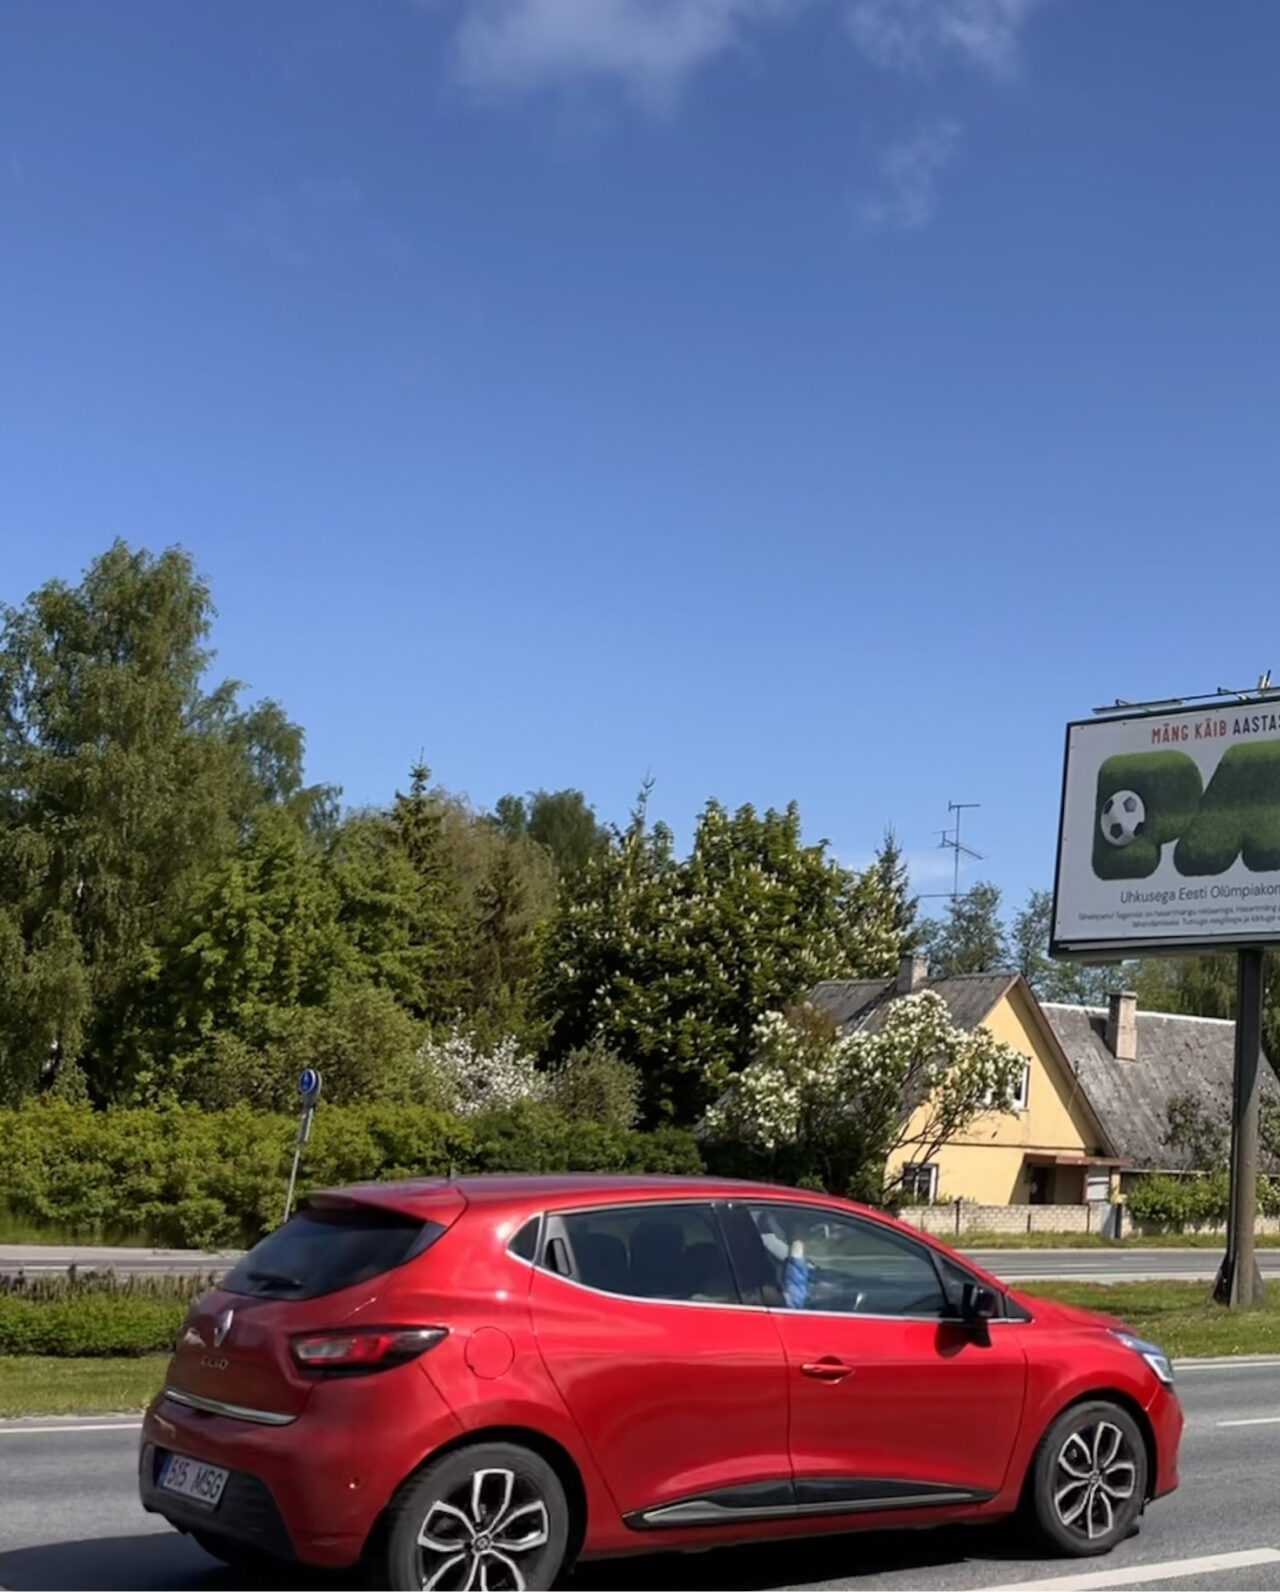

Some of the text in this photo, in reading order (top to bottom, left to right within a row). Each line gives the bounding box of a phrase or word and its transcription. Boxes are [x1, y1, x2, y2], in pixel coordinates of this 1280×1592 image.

[1151, 722, 1189, 744] MÄNG
[1194, 717, 1227, 740] KÄIB
[1120, 889, 1176, 905] Uhkusega
[1178, 886, 1208, 900] Eesti
[191, 1467, 223, 1498] MSG
